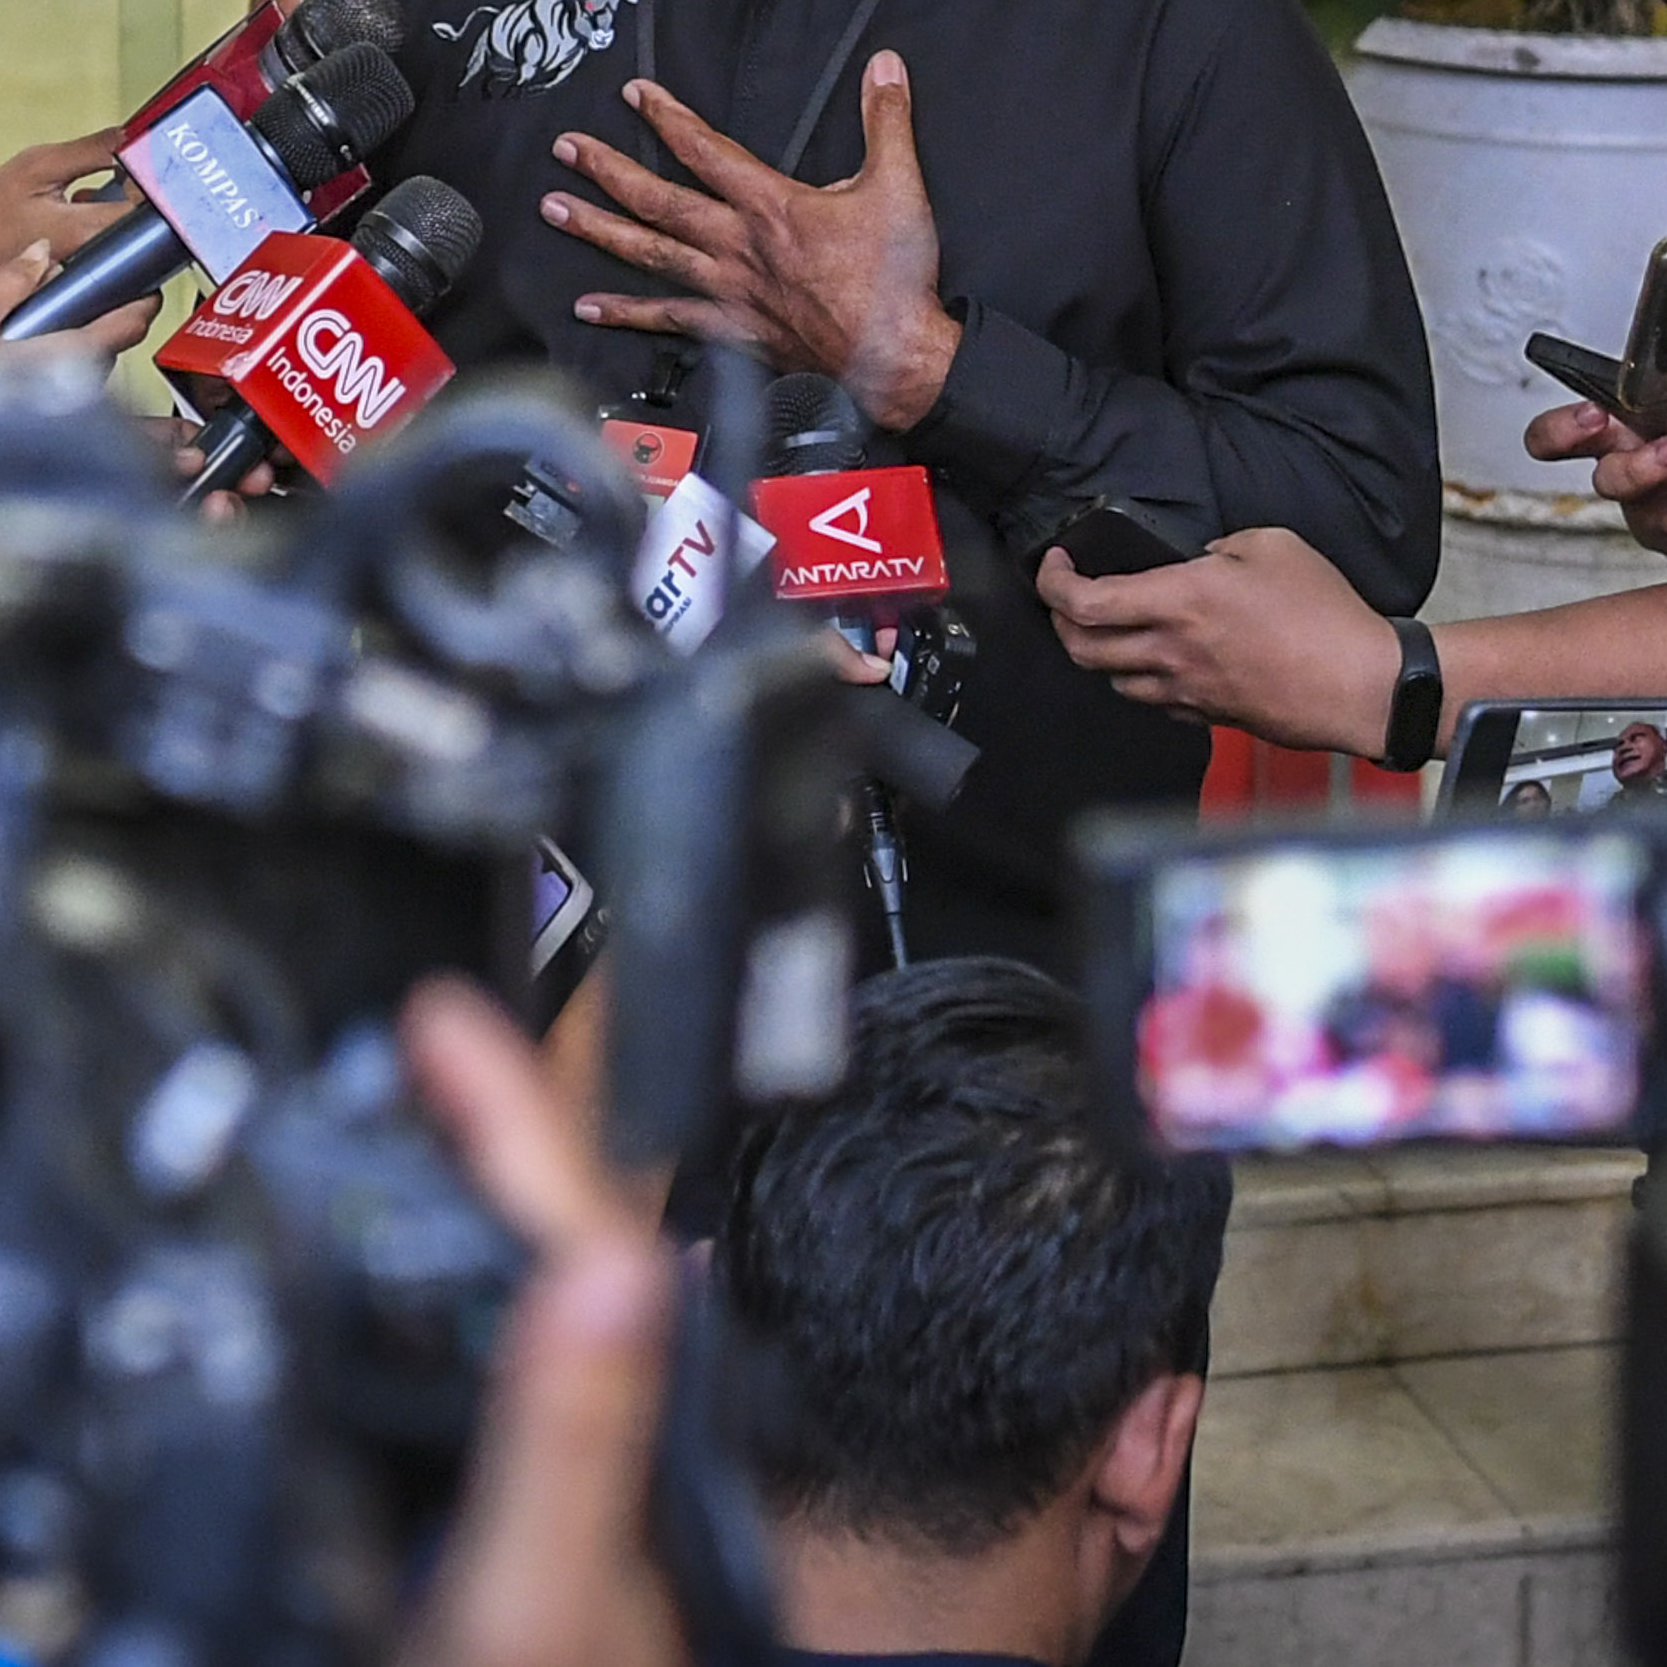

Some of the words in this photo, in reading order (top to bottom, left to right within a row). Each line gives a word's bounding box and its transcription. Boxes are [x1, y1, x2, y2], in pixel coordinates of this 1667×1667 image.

[167, 123, 260, 229] KOMPAS
[184, 314, 255, 345] Indonesia
[212, 269, 304, 321] CNN
[266, 346, 356, 455] Indonesia
[296, 308, 407, 429] CNN
